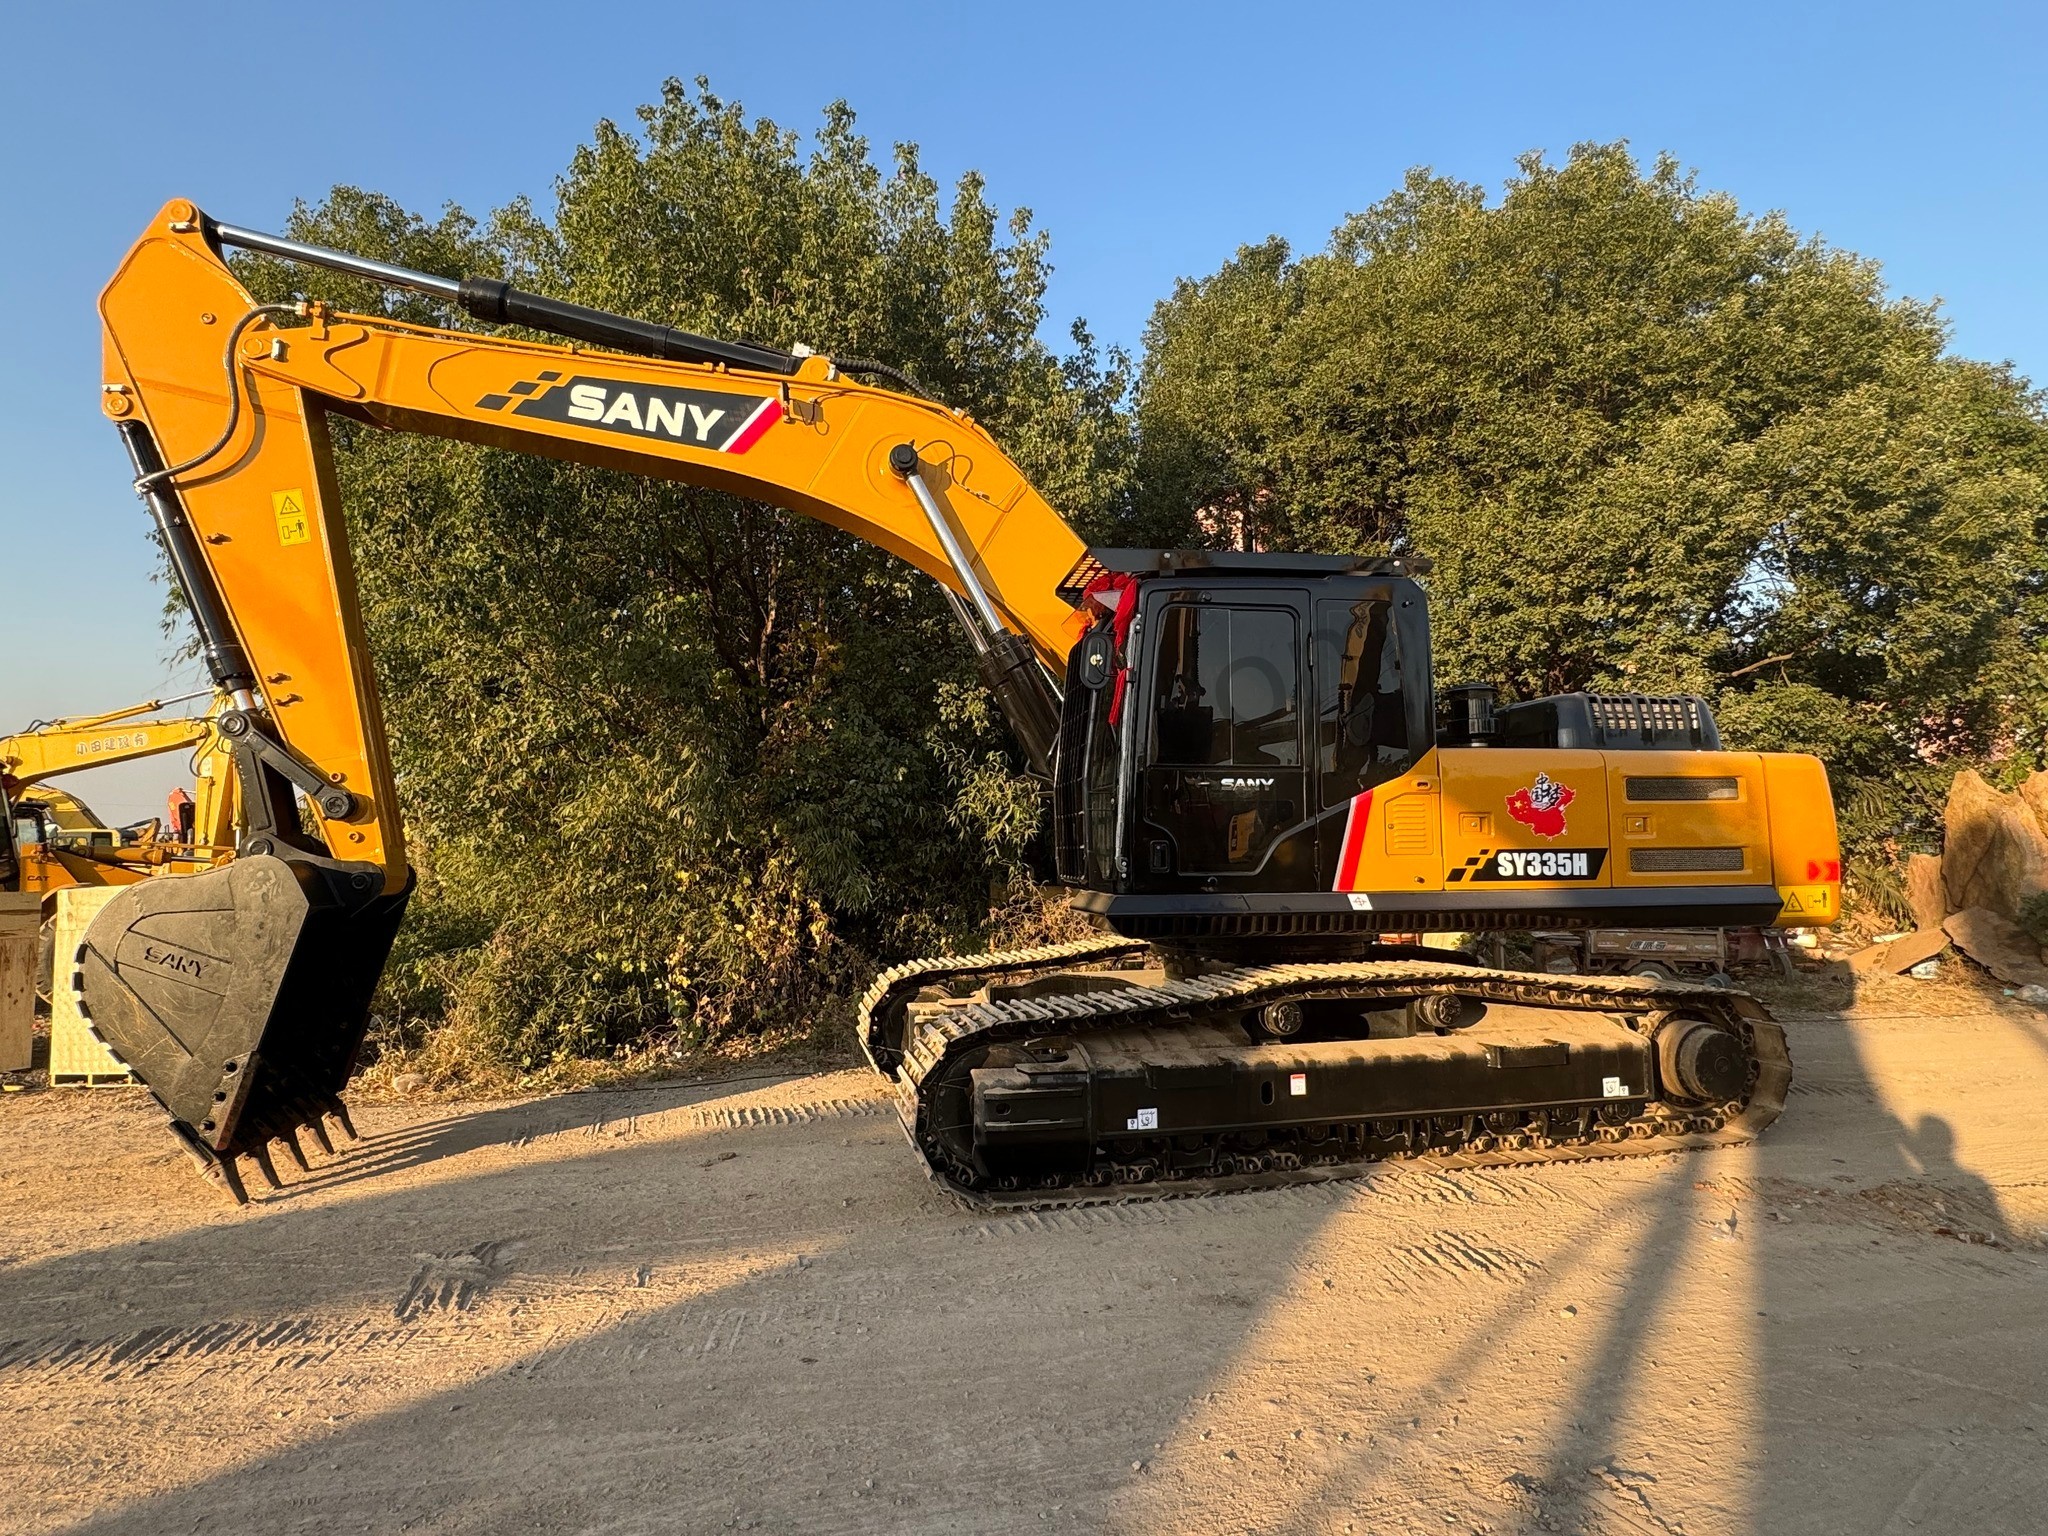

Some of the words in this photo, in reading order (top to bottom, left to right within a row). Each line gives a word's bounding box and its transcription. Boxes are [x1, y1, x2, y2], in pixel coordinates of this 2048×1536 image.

[568, 384, 726, 442] SANY
[1220, 777, 1275, 792] SANY
[1497, 852, 1588, 877] SY335H
[144, 946, 209, 979] SANY
